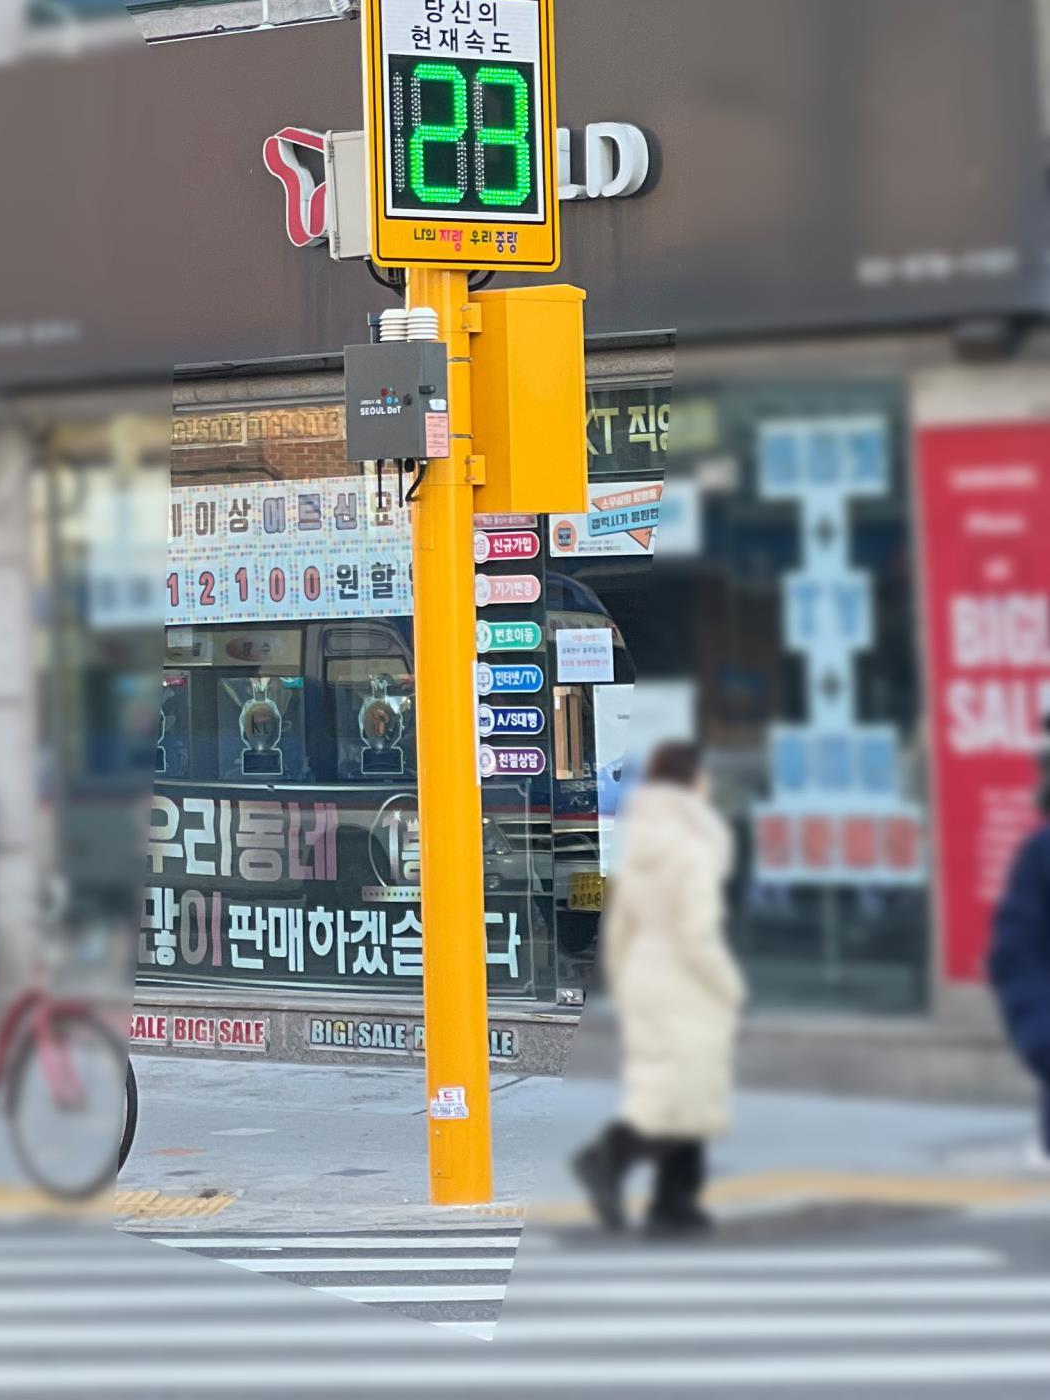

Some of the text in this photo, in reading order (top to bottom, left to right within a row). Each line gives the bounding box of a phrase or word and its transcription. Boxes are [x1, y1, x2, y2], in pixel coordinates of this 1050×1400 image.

[411, 25, 512, 54] 현재속도
[409, 63, 531, 206] 23
[413, 228, 436, 241] 나의
[469, 230, 492, 245] 우리
[495, 231, 518, 254] 중랑
[360, 407, 386, 416] SEOUL
[493, 537, 532, 554] 신규가입
[494, 581, 532, 597] 기기변경
[495, 627, 534, 645] 번호이동
[495, 670, 537, 687] 인터넷/TV
[497, 712, 538, 730] A/S대행
[498, 752, 538, 771] 친절상담
[228, 903, 521, 978] 판매하겠습다
[174, 1018, 214, 1042] BIG!
[218, 1018, 264, 1045] SALE
[310, 1019, 354, 1045] BIG!
[358, 1023, 406, 1049] SALE
